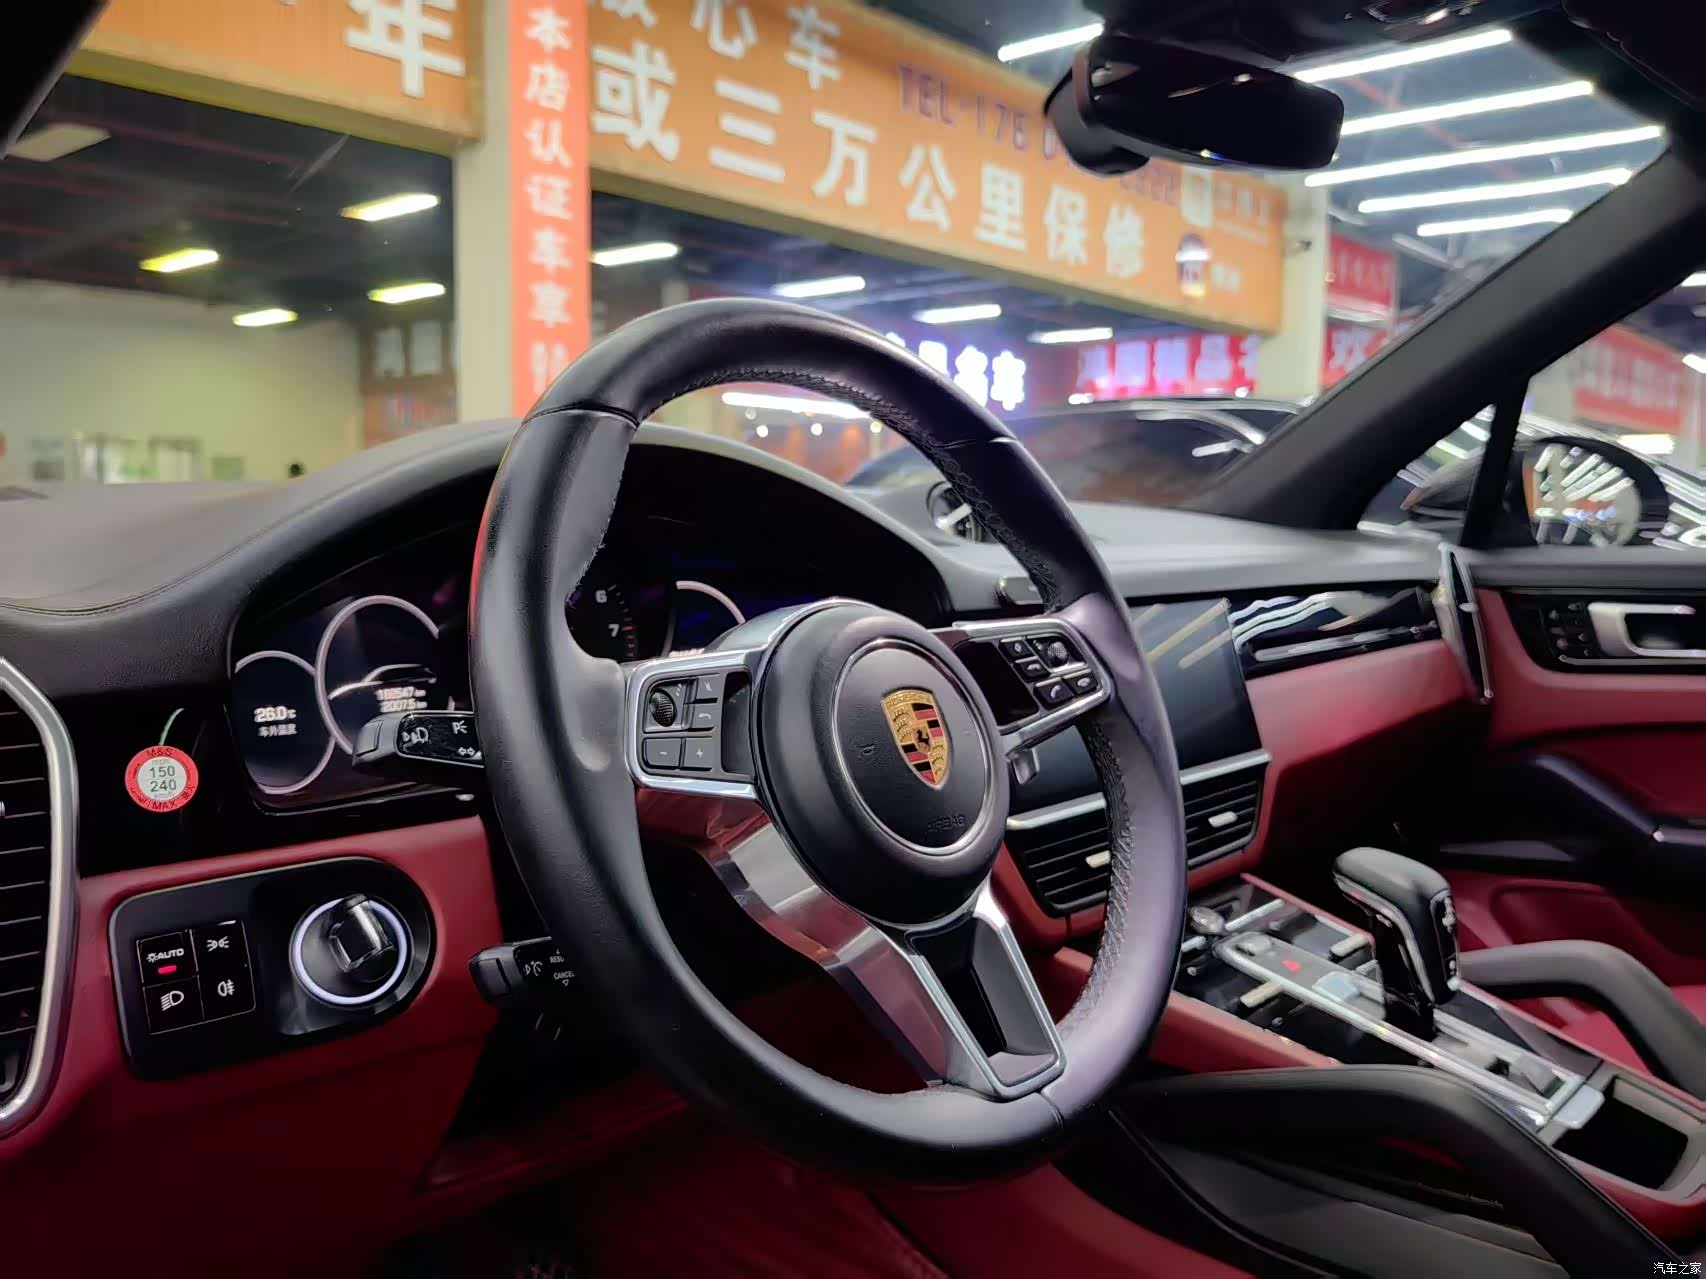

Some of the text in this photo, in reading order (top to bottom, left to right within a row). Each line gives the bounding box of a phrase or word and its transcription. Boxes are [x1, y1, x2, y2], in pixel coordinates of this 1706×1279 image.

[591, 40, 1145, 278] 或三万公里保修
[595, 590, 607, 603] 6
[608, 623, 619, 637] 7
[149, 765, 176, 778] 150
[150, 779, 177, 792] 240
[157, 948, 184, 959] AUTO
